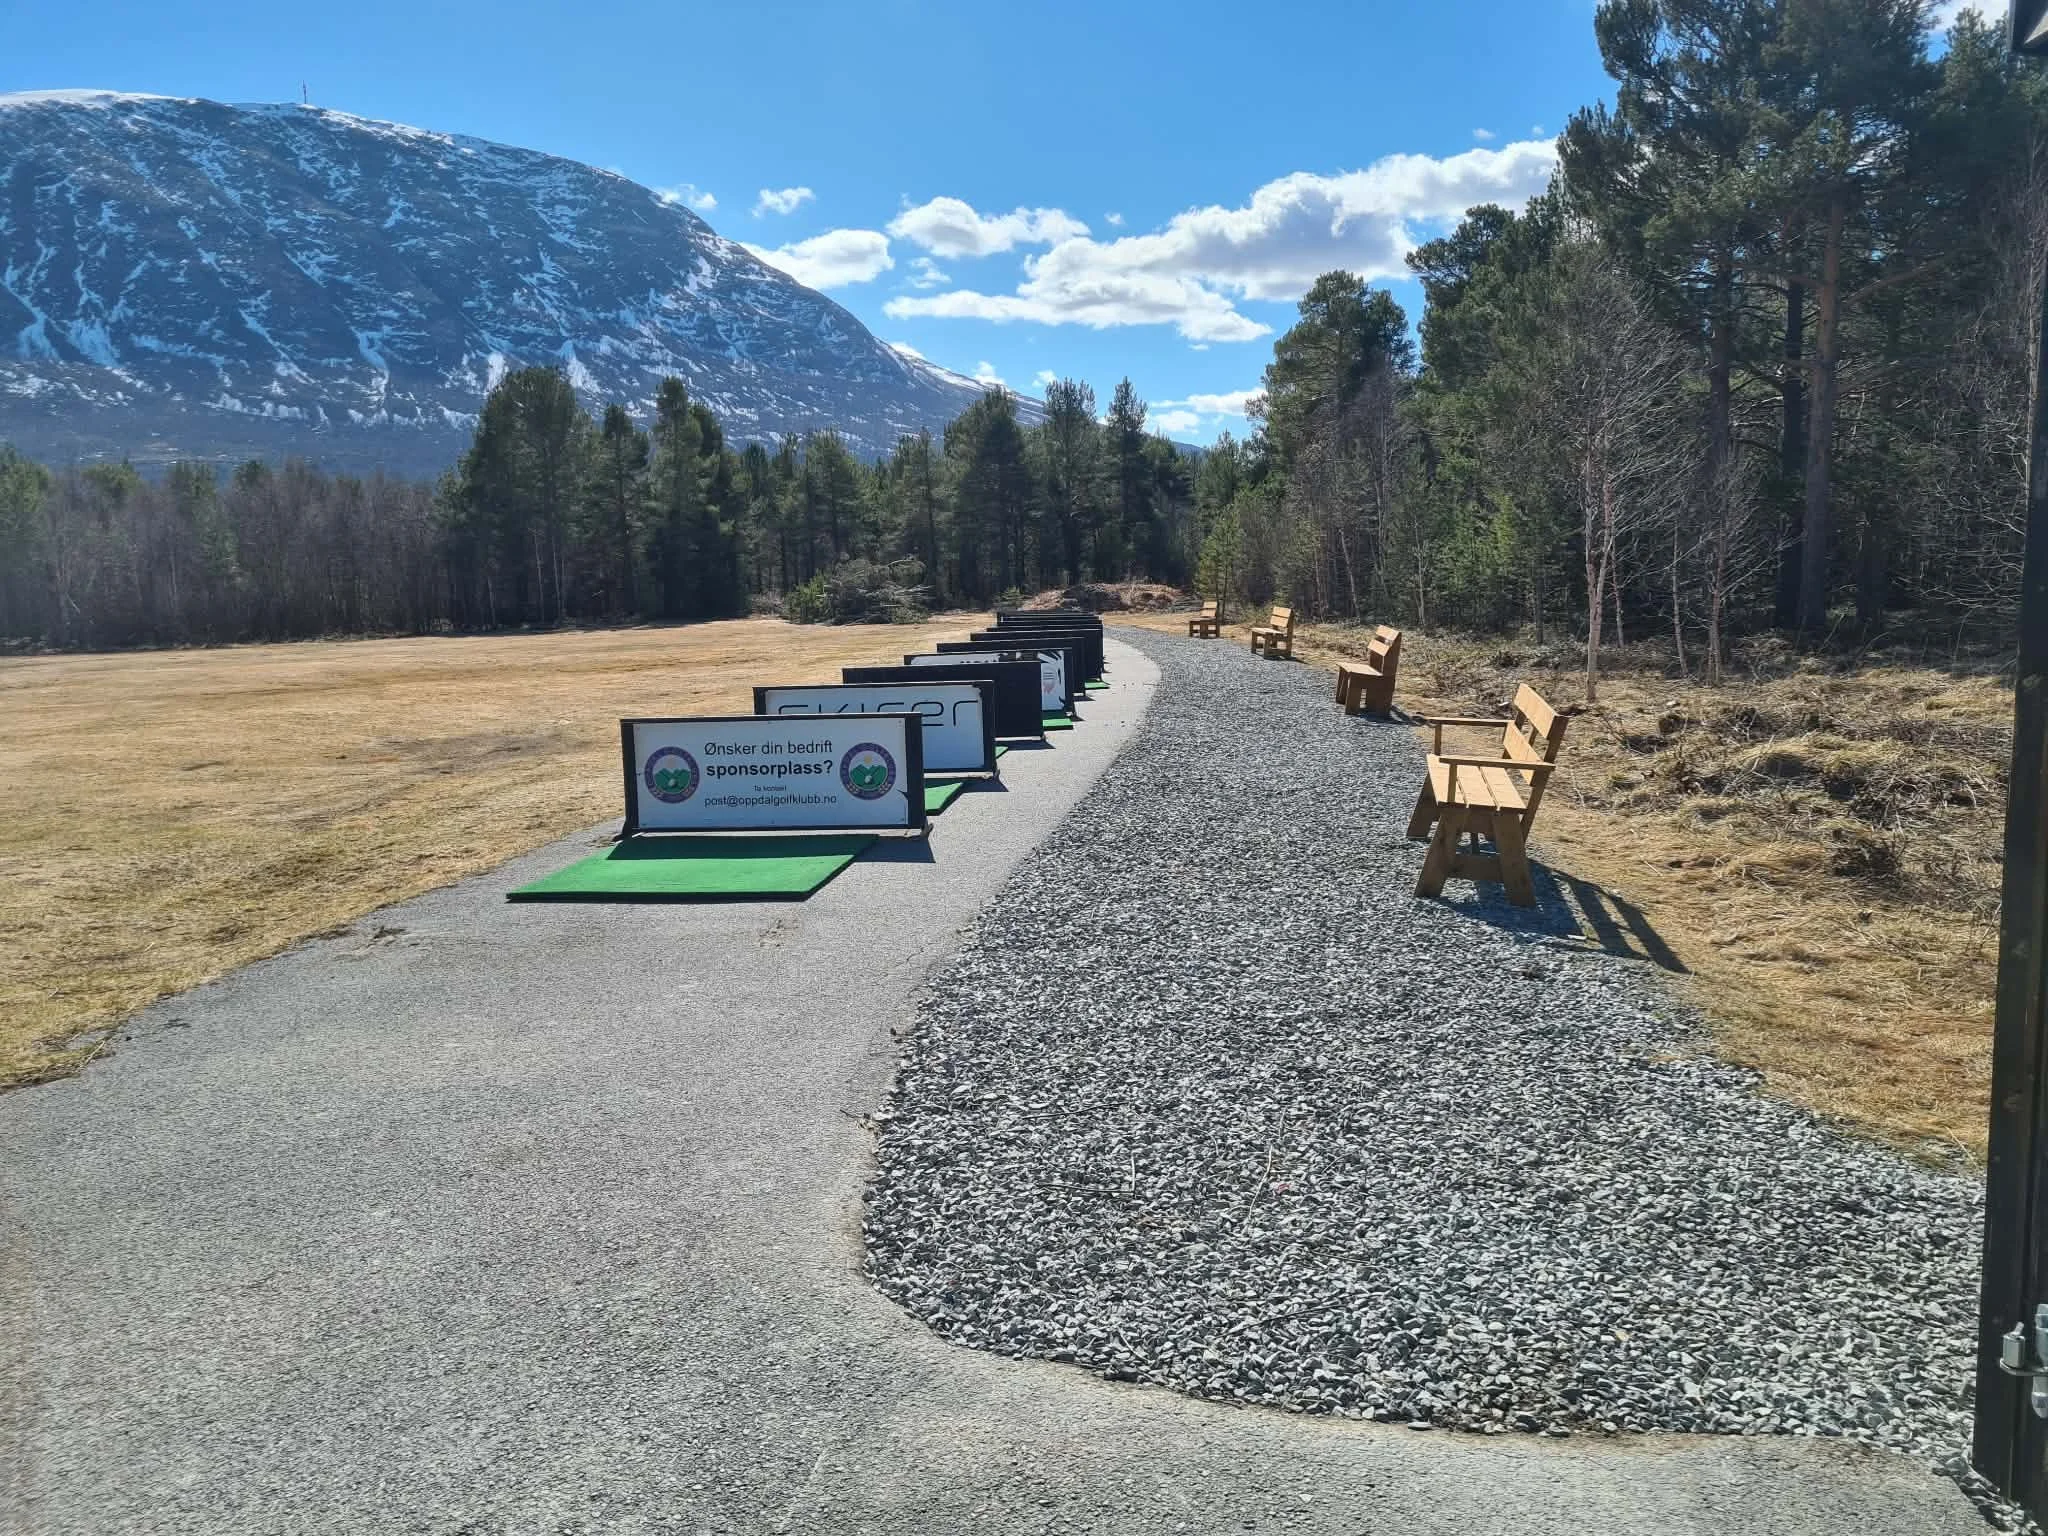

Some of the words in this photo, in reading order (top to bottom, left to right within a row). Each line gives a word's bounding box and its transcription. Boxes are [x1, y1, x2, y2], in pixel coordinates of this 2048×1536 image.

[704, 742, 757, 756] Ønsker
[761, 740, 783, 755] din
[787, 739, 833, 753] bedrift
[706, 759, 833, 779] sponsorplass?
